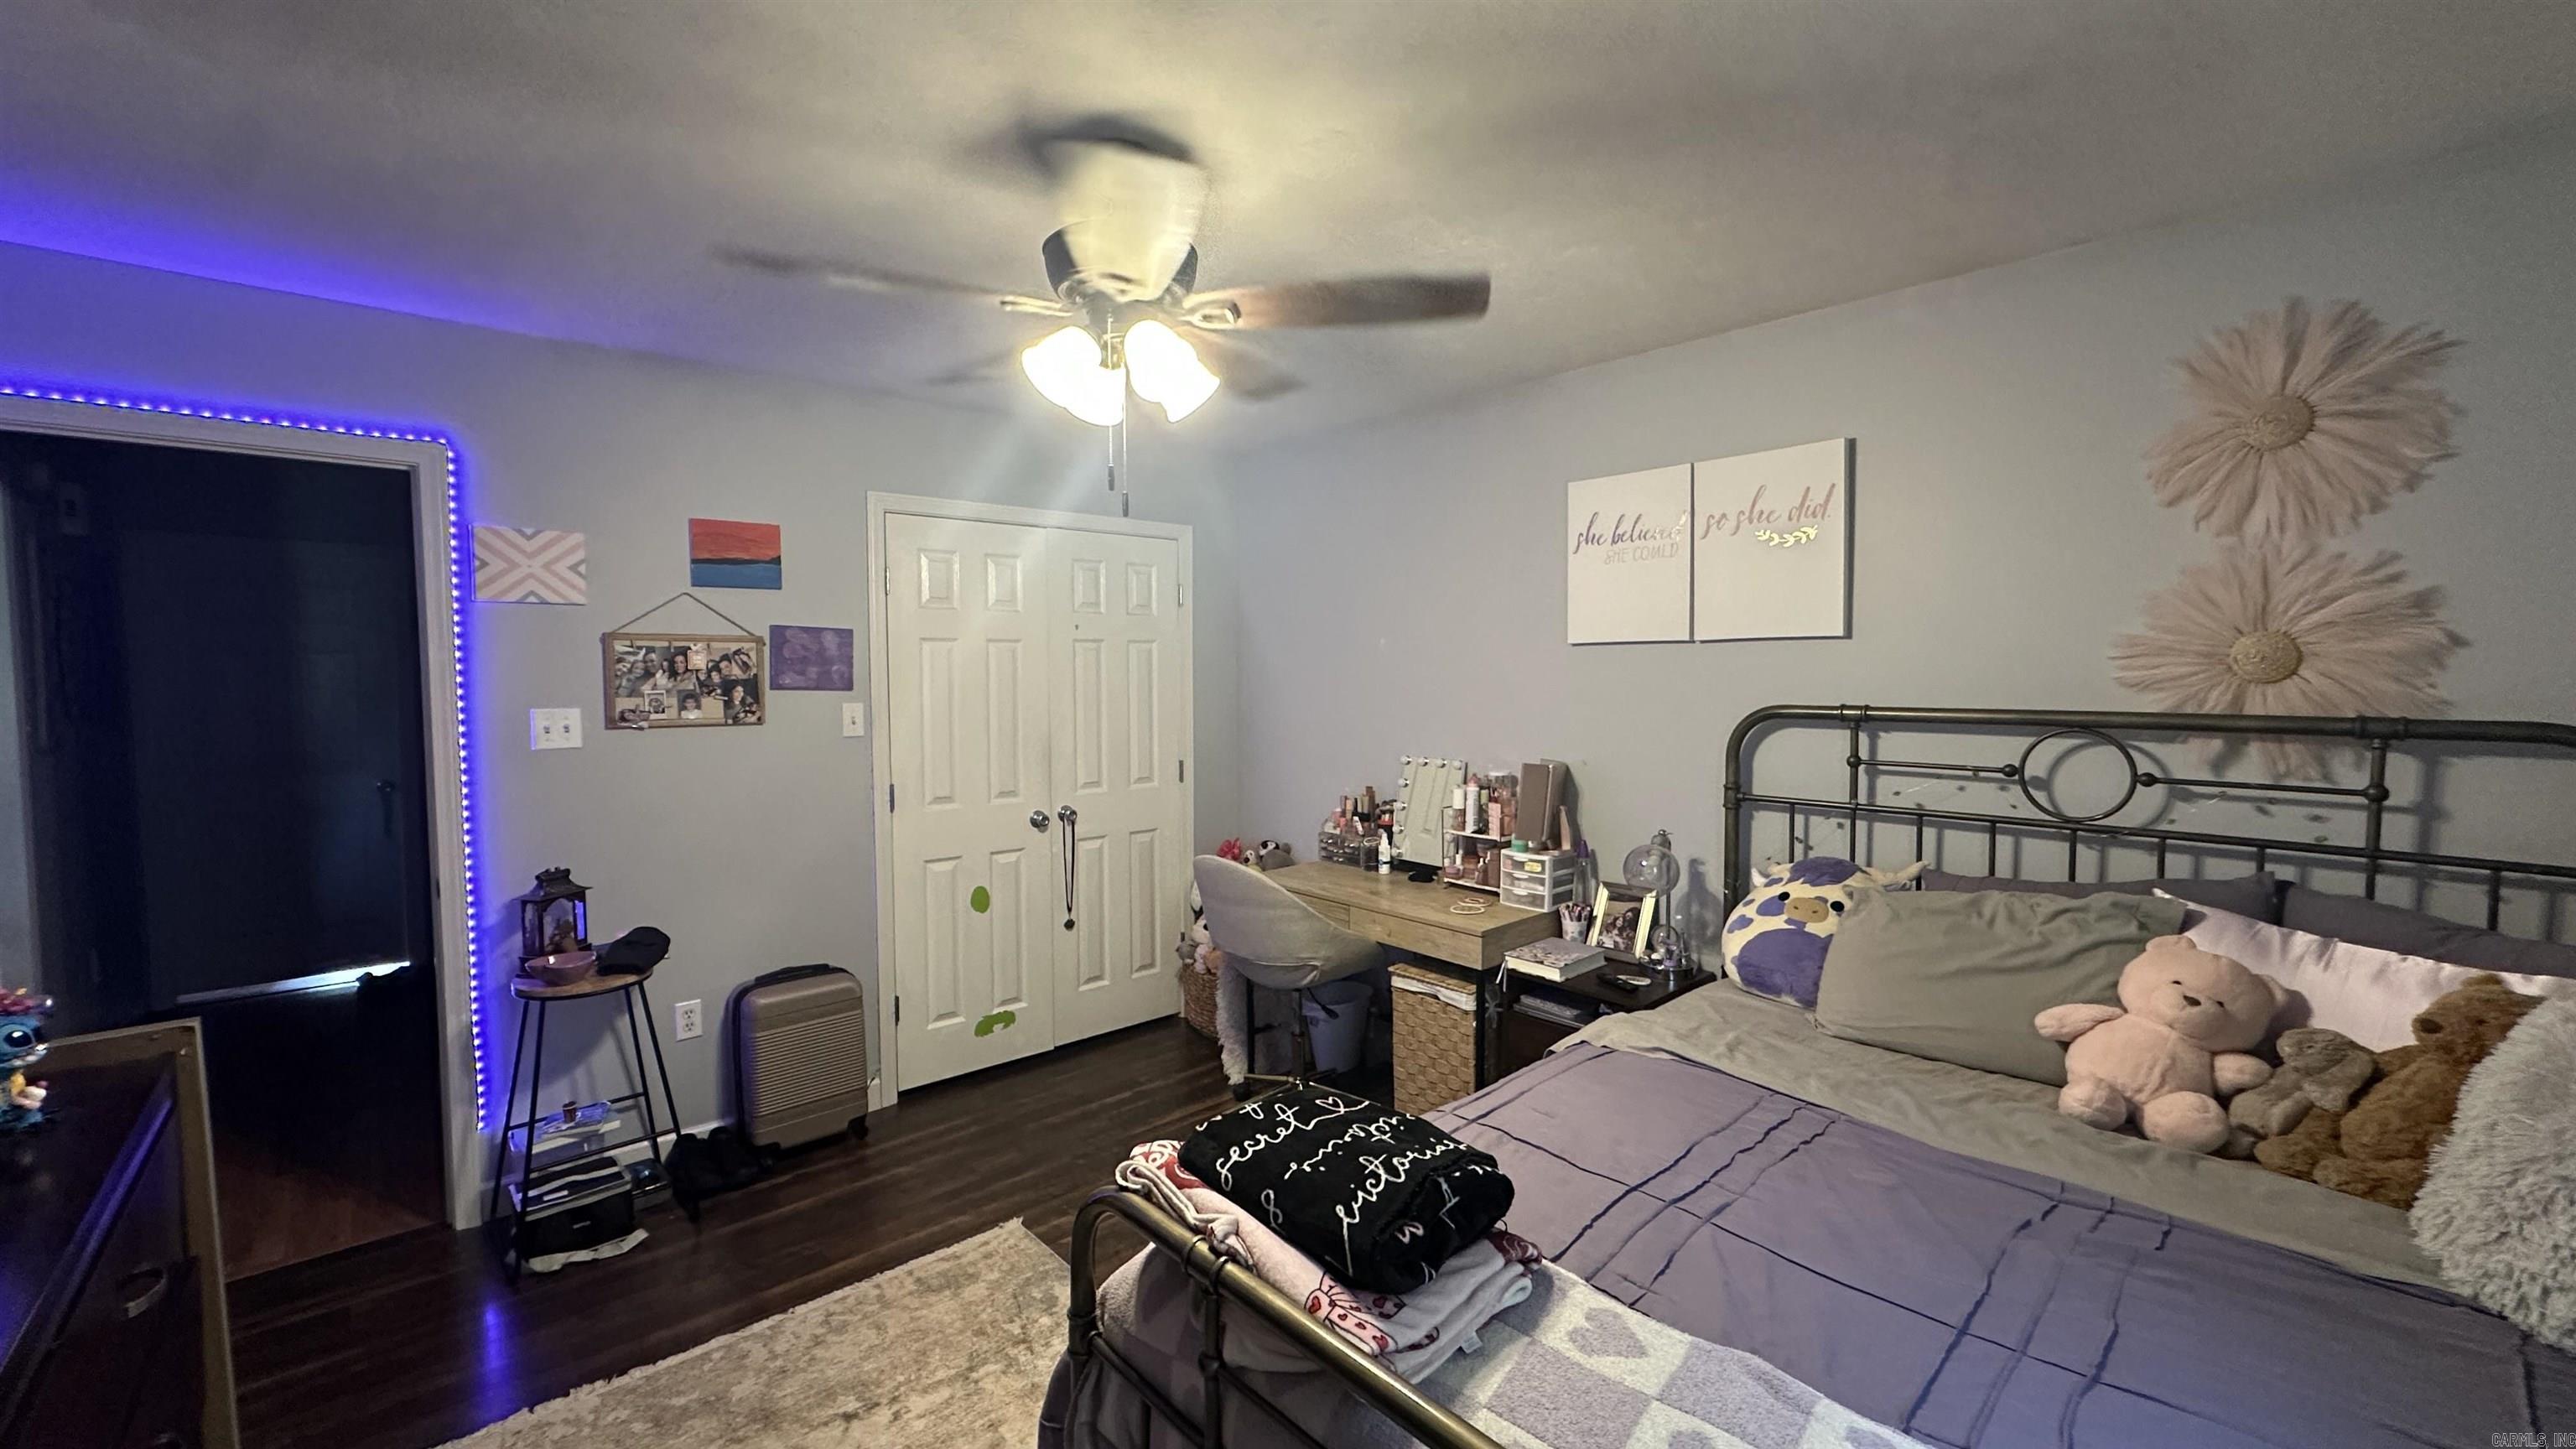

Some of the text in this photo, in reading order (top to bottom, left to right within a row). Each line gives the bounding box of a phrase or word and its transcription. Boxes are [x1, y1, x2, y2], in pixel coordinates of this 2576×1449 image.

[1700, 482, 1836, 540] so she did.
[1572, 512, 1608, 555] she
[1604, 543, 1680, 566] SHE COULD
